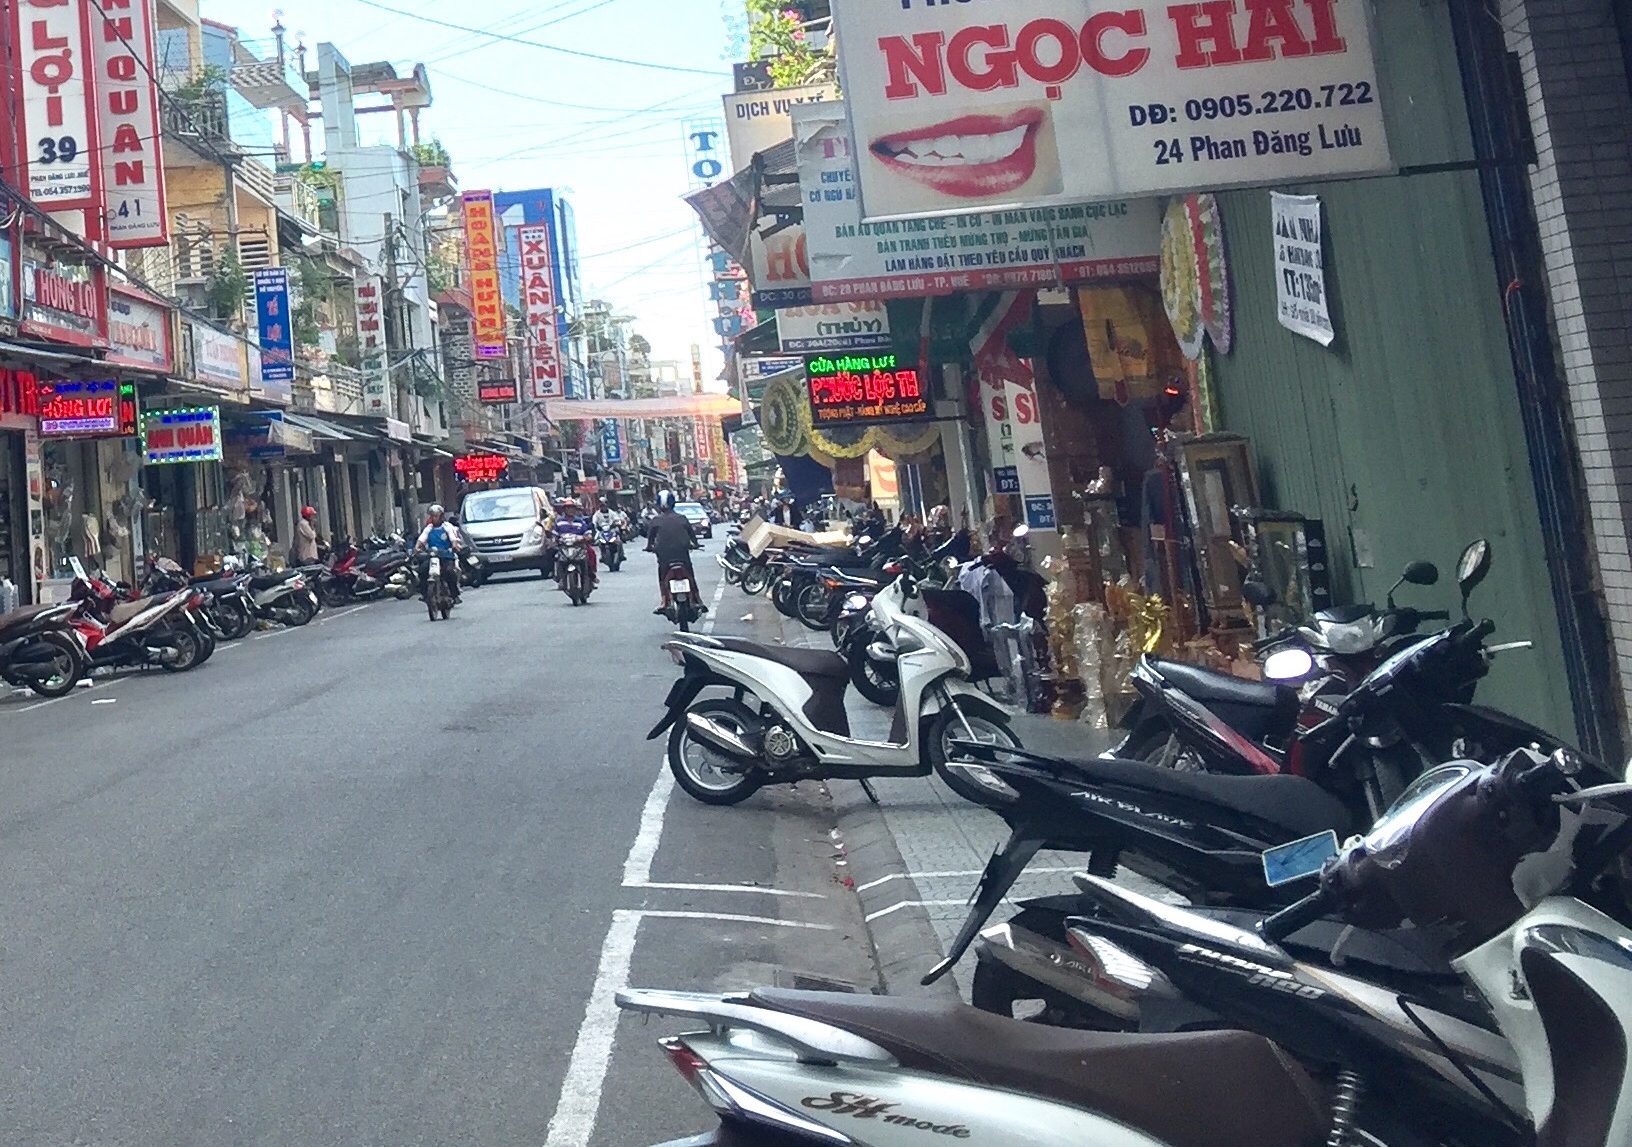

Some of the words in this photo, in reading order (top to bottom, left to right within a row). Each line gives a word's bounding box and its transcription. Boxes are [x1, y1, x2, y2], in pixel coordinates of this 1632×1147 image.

[31, 19, 72, 127] LỢI
[878, 8, 1149, 100] NGỌC
[107, 55, 144, 186] QUÂN
[1130, 102, 1177, 127] DĐ:
[1185, 81, 1373, 121] 0905.220.722
[38, 136, 76, 164] 39
[1153, 139, 1184, 165] 24
[1190, 132, 1247, 161] Phan
[1252, 127, 1312, 159] Đăng
[1319, 121, 1361, 149] Lưu
[524, 240, 549, 305] XUÂN
[800, 1091, 902, 1122] SH
[884, 1112, 972, 1140] mode
